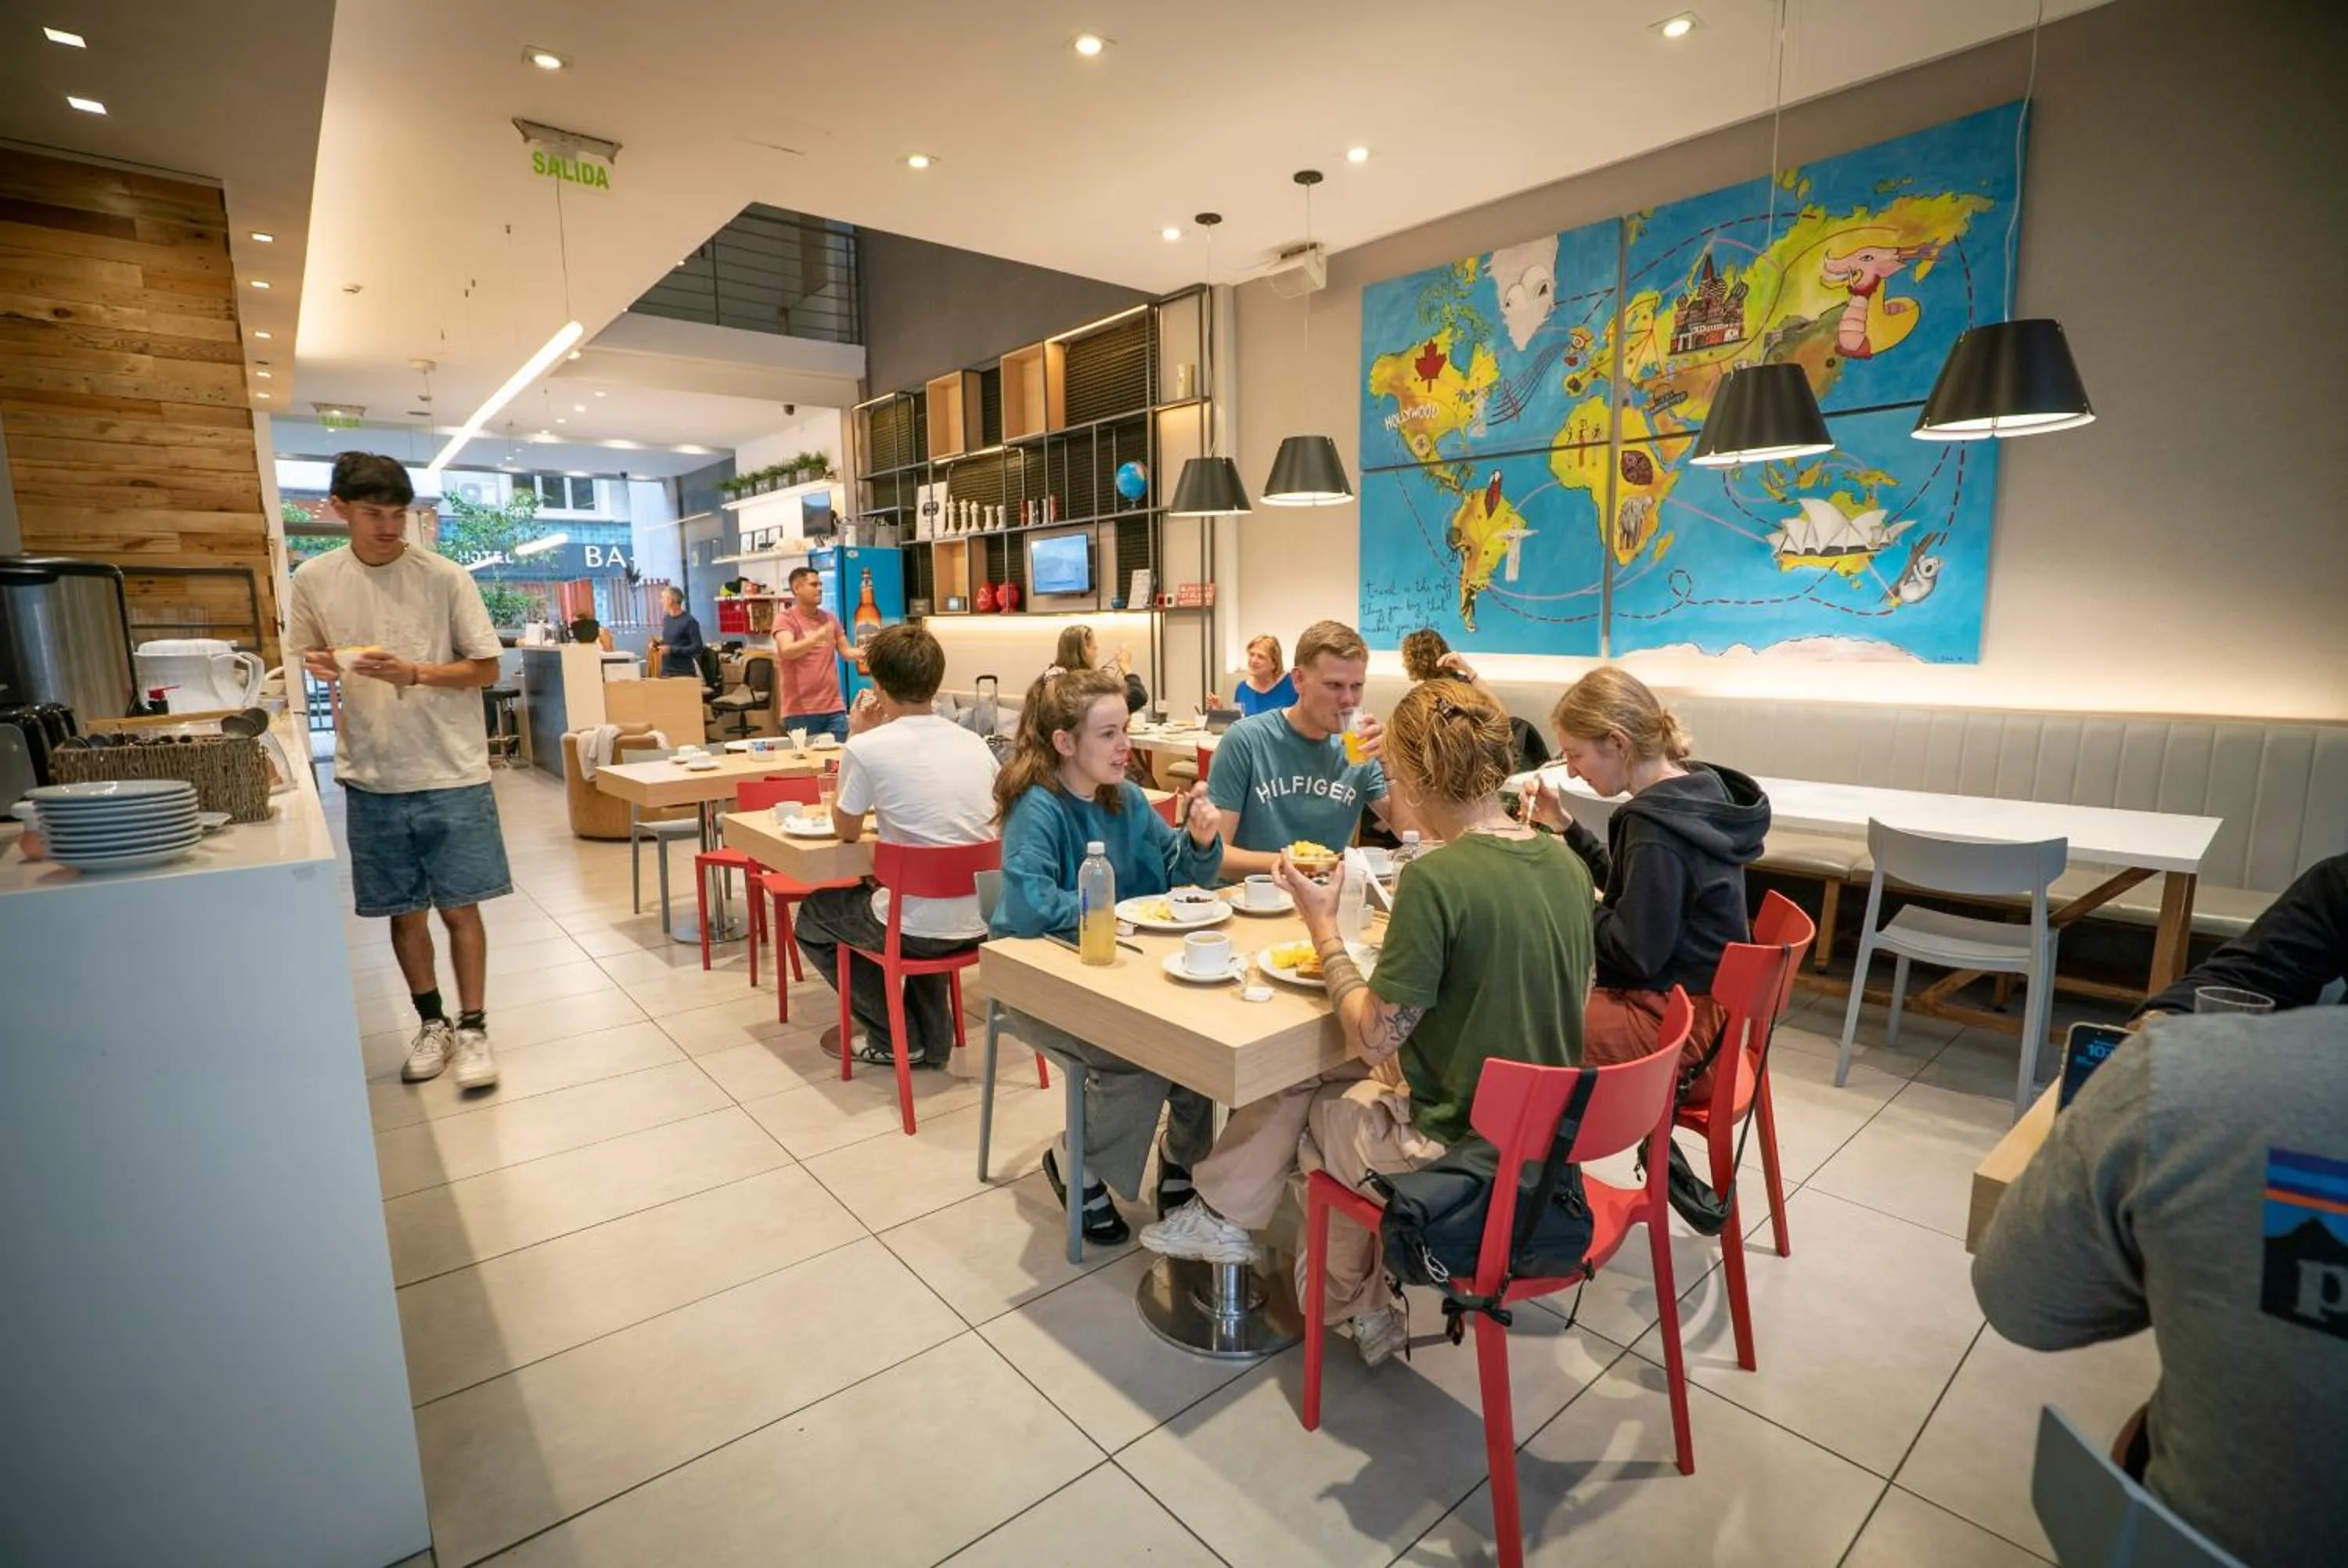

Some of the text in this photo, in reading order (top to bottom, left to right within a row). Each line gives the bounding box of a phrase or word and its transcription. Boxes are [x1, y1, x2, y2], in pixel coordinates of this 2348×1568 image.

[533, 151, 610, 189] SALIDA
[585, 545, 636, 568] BA
[1255, 775, 1356, 807] HILFIGER
